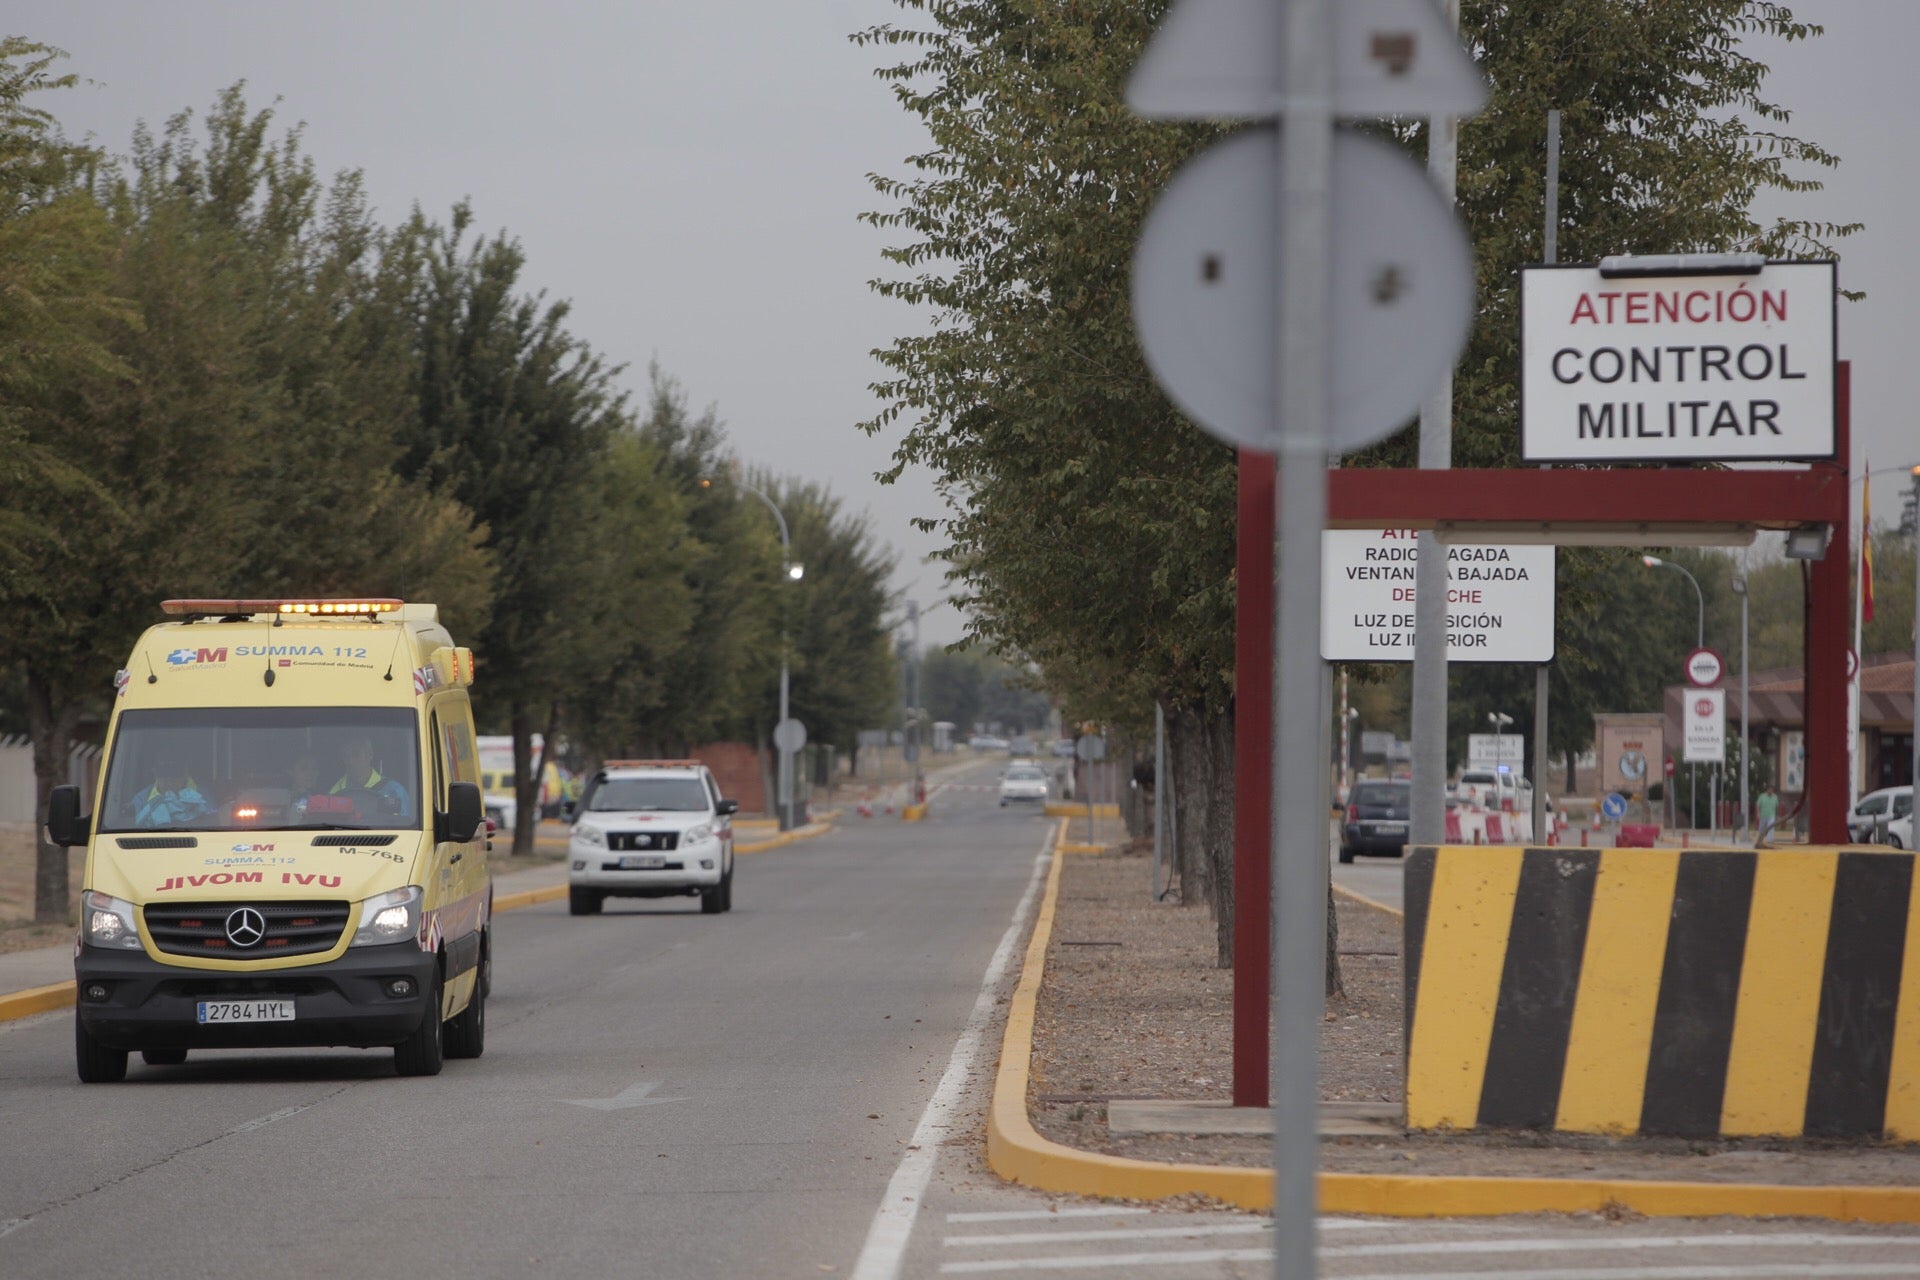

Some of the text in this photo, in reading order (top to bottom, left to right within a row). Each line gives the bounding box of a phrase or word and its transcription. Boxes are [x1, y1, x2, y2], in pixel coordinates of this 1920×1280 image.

[1570, 283, 1787, 324] ATENCIÓN
[1552, 344, 1806, 384] CONTROL
[1578, 399, 1781, 438] MILITAR
[1365, 548, 1510, 561] RADIO AGADA
[1346, 567, 1529, 581] VENTAN BAJADA
[1392, 588, 1482, 603] DE CHE
[1354, 612, 1502, 628] LUZ DE SICIÓN
[1369, 634, 1487, 647] LUZ IRIOR
[235, 646, 324, 656] SUMMA
[333, 647, 367, 658] 112
[204, 857, 264, 865] SUMMA
[210, 1003, 289, 1020] 2784 HYL
